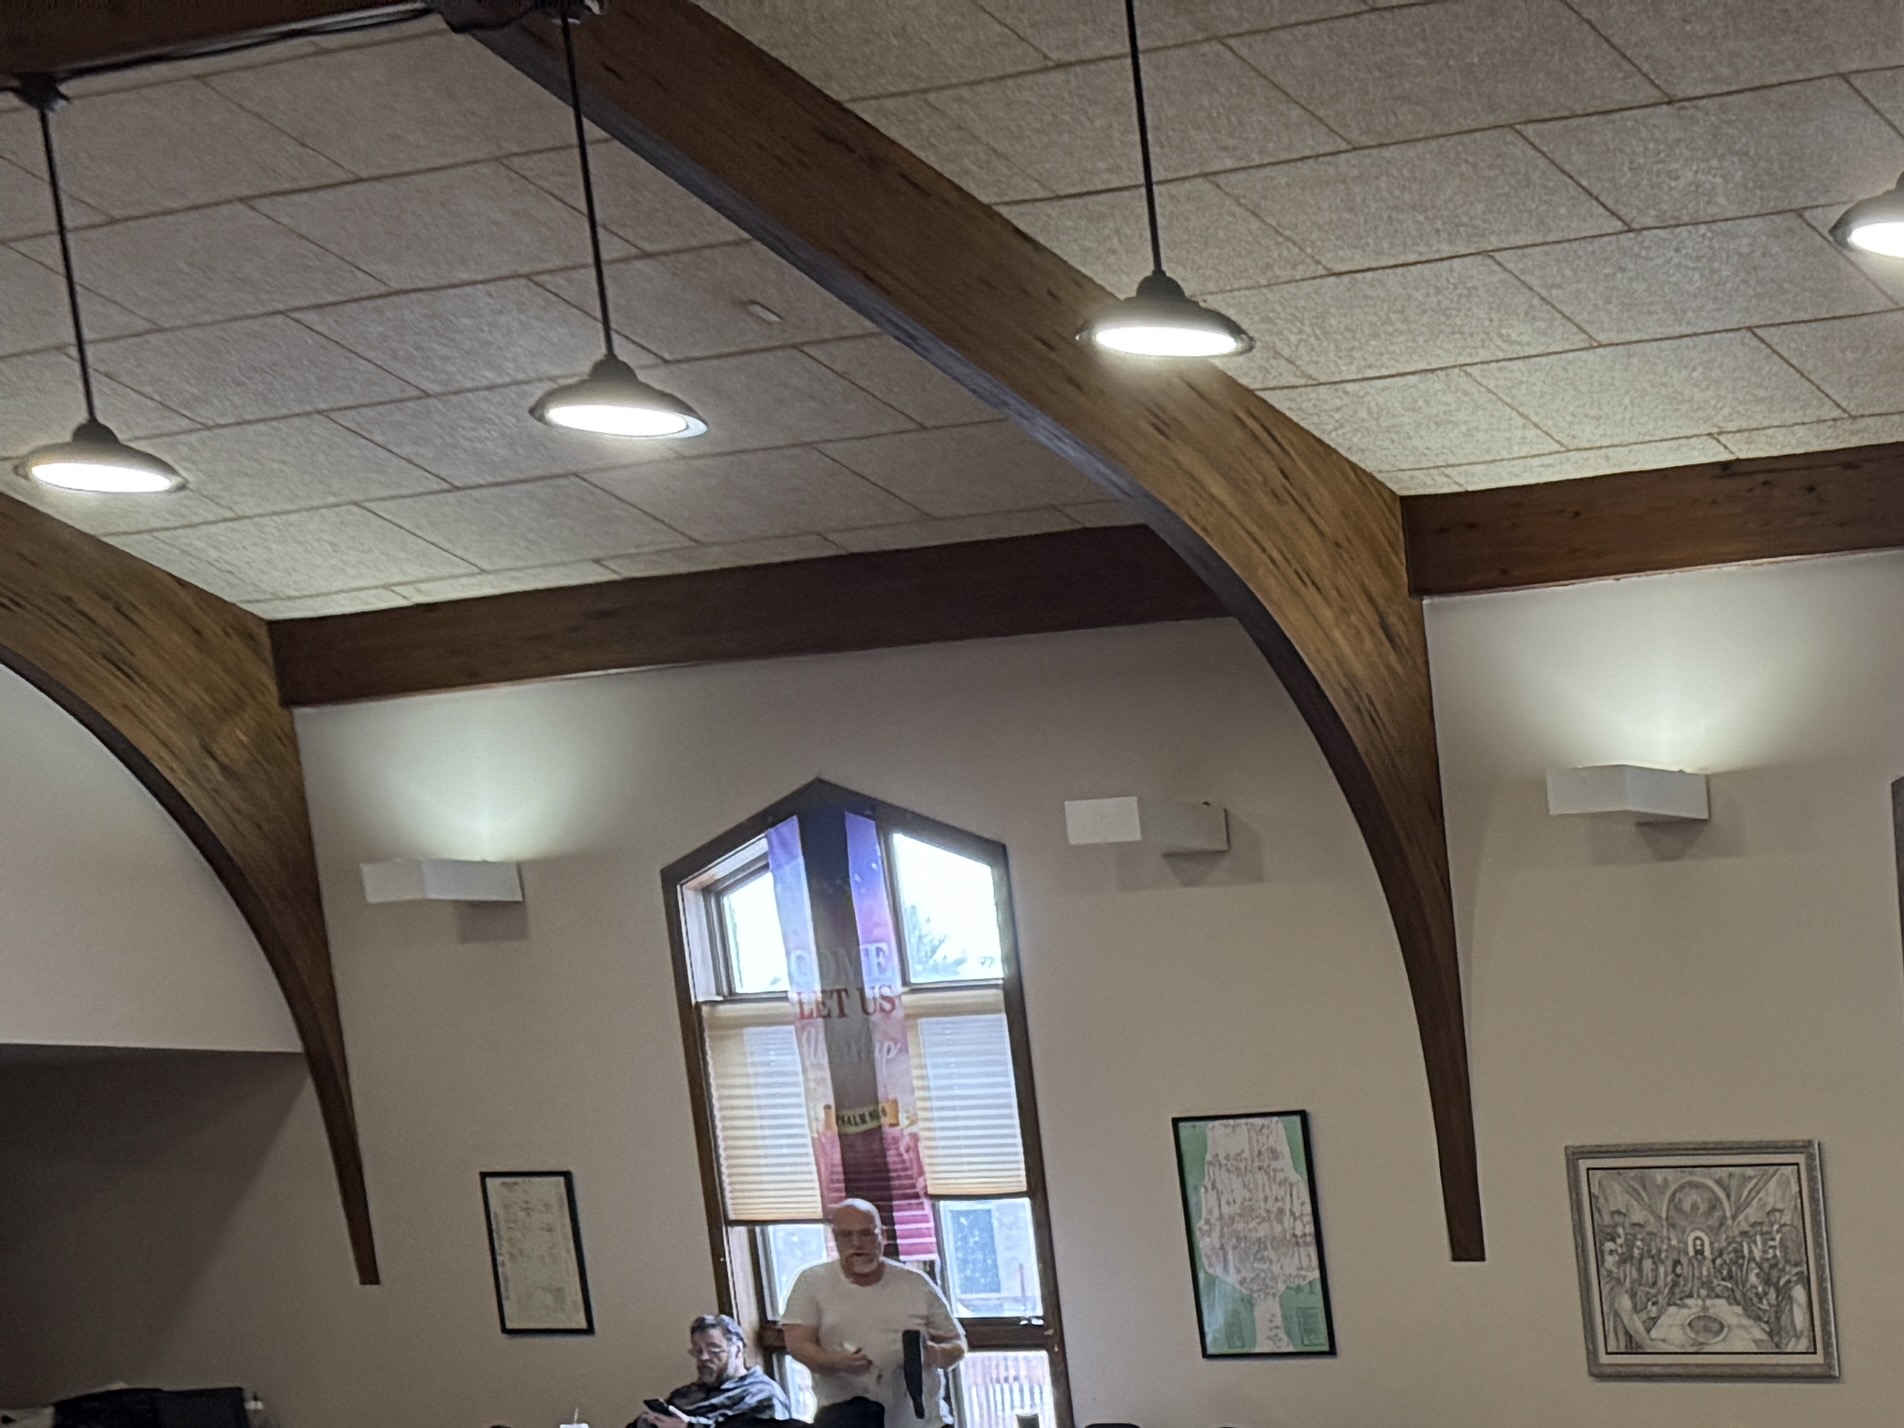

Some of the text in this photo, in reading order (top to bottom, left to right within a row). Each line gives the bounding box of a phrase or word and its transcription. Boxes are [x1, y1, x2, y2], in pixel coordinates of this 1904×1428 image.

[788, 944, 889, 984] COME
[797, 984, 896, 1020] LET US
